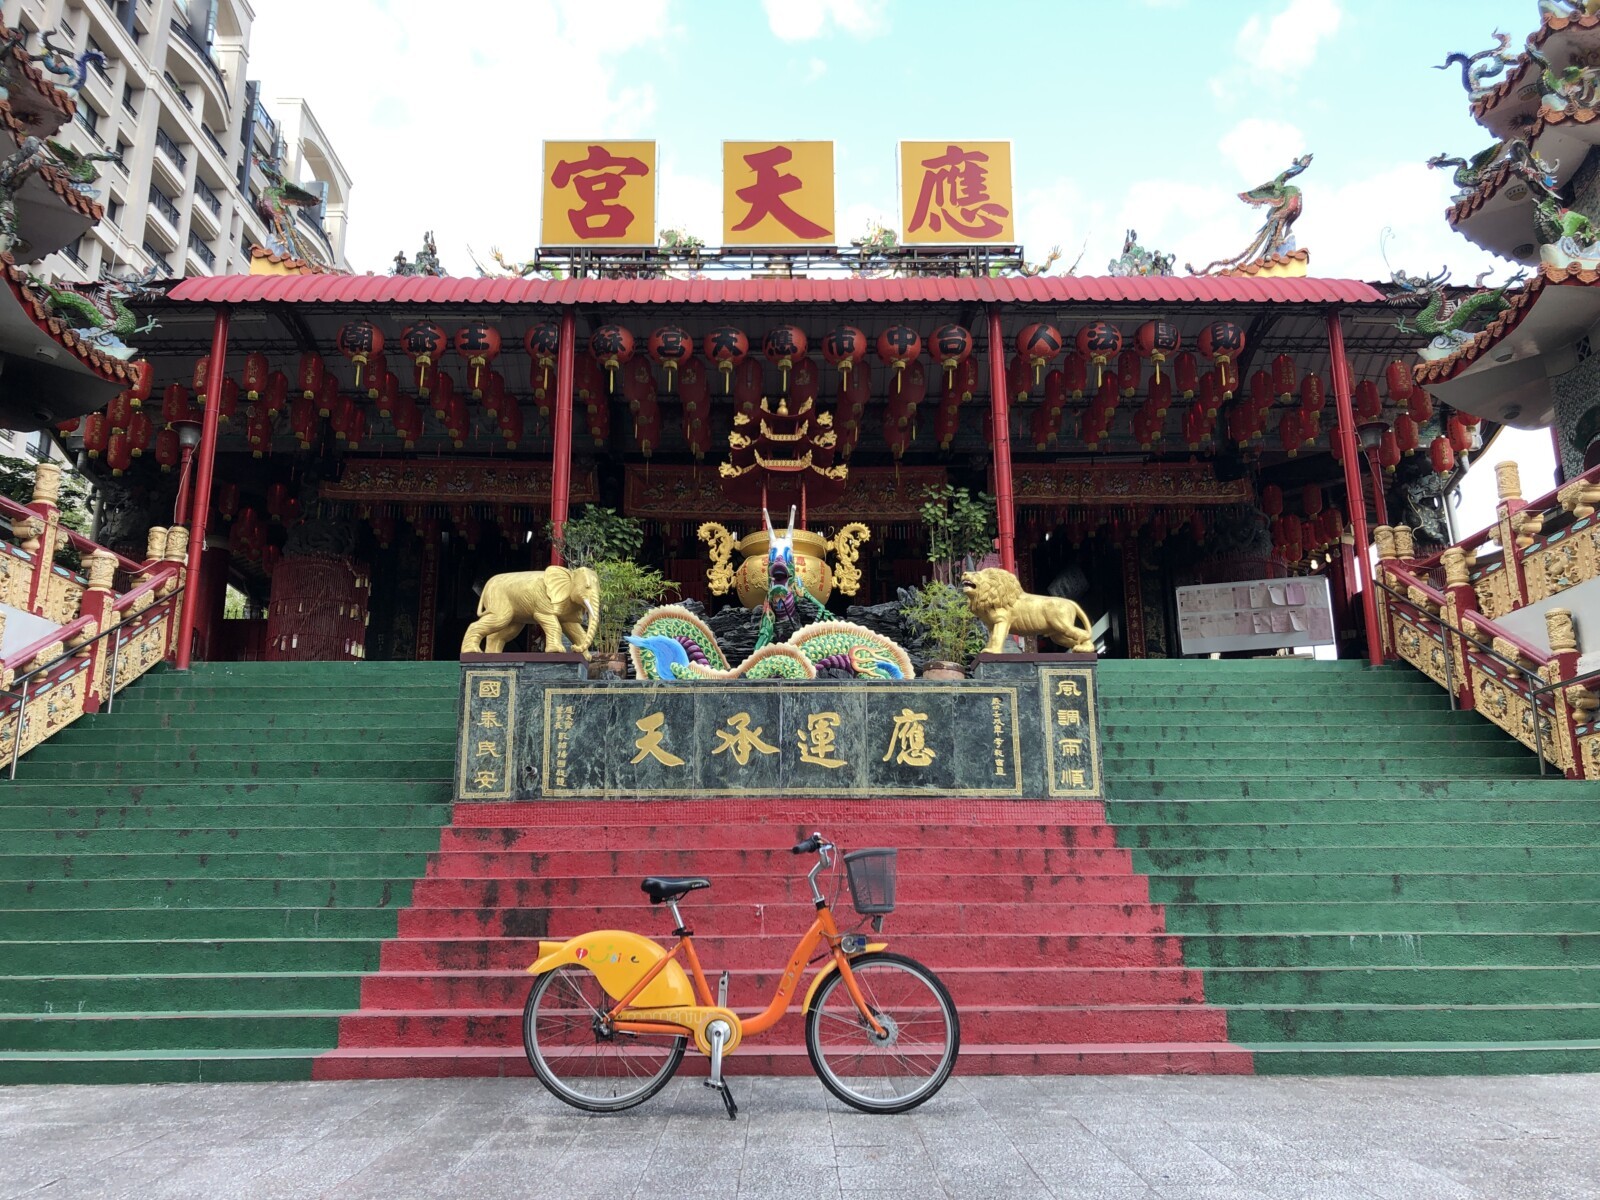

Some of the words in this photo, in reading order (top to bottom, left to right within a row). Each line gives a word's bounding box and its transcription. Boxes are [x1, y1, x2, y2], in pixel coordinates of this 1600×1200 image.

[474, 680, 503, 789] 國泰民安
[1055, 680, 1086, 788] 風調雨順
